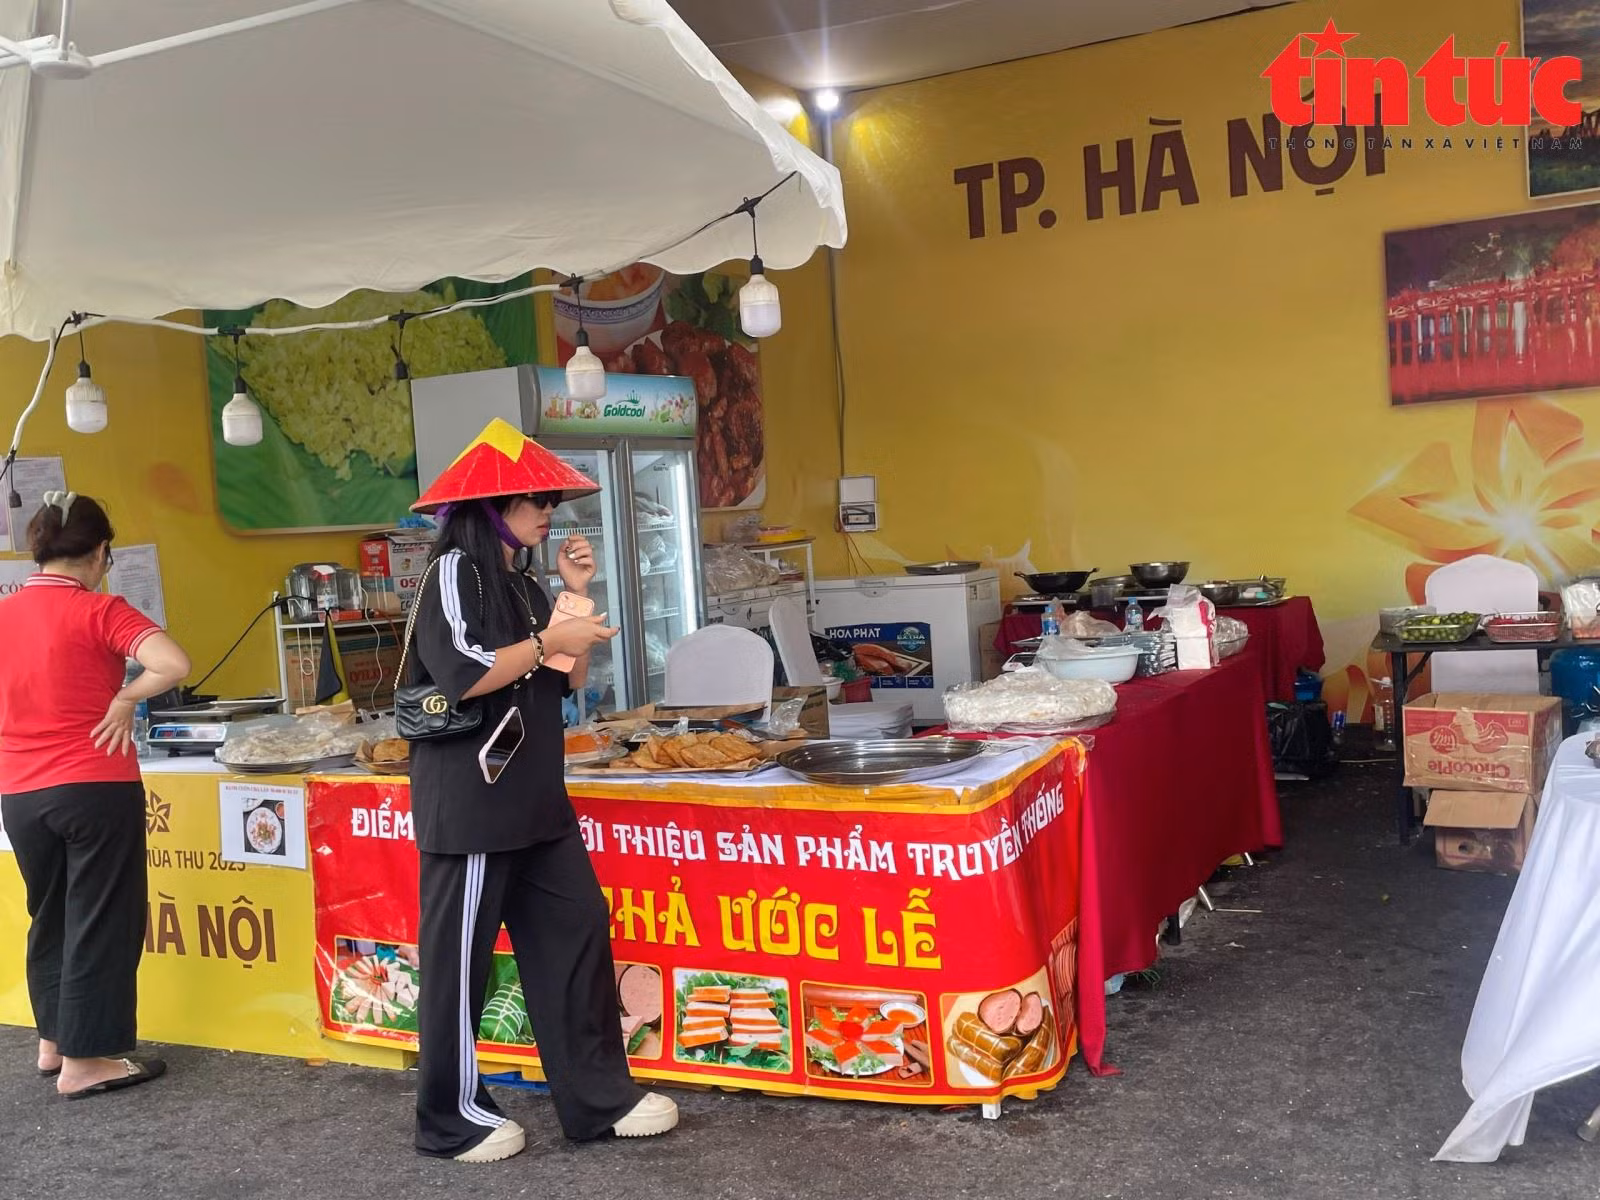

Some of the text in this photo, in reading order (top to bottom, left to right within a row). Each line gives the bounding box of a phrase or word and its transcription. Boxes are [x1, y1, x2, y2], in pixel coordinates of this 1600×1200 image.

[954, 156, 1057, 239] TP.
[1083, 117, 1199, 221] HÀ
[603, 404, 646, 417] Goldcool
[175, 850, 204, 870] THU
[351, 781, 1065, 881] ĐIỂM ỚI THIỆU SẢN PHẨM TRUYỀN THỐNG
[197, 895, 277, 969] NỘI
[718, 886, 840, 961] ƯỚC
[862, 887, 942, 969] LỄ
